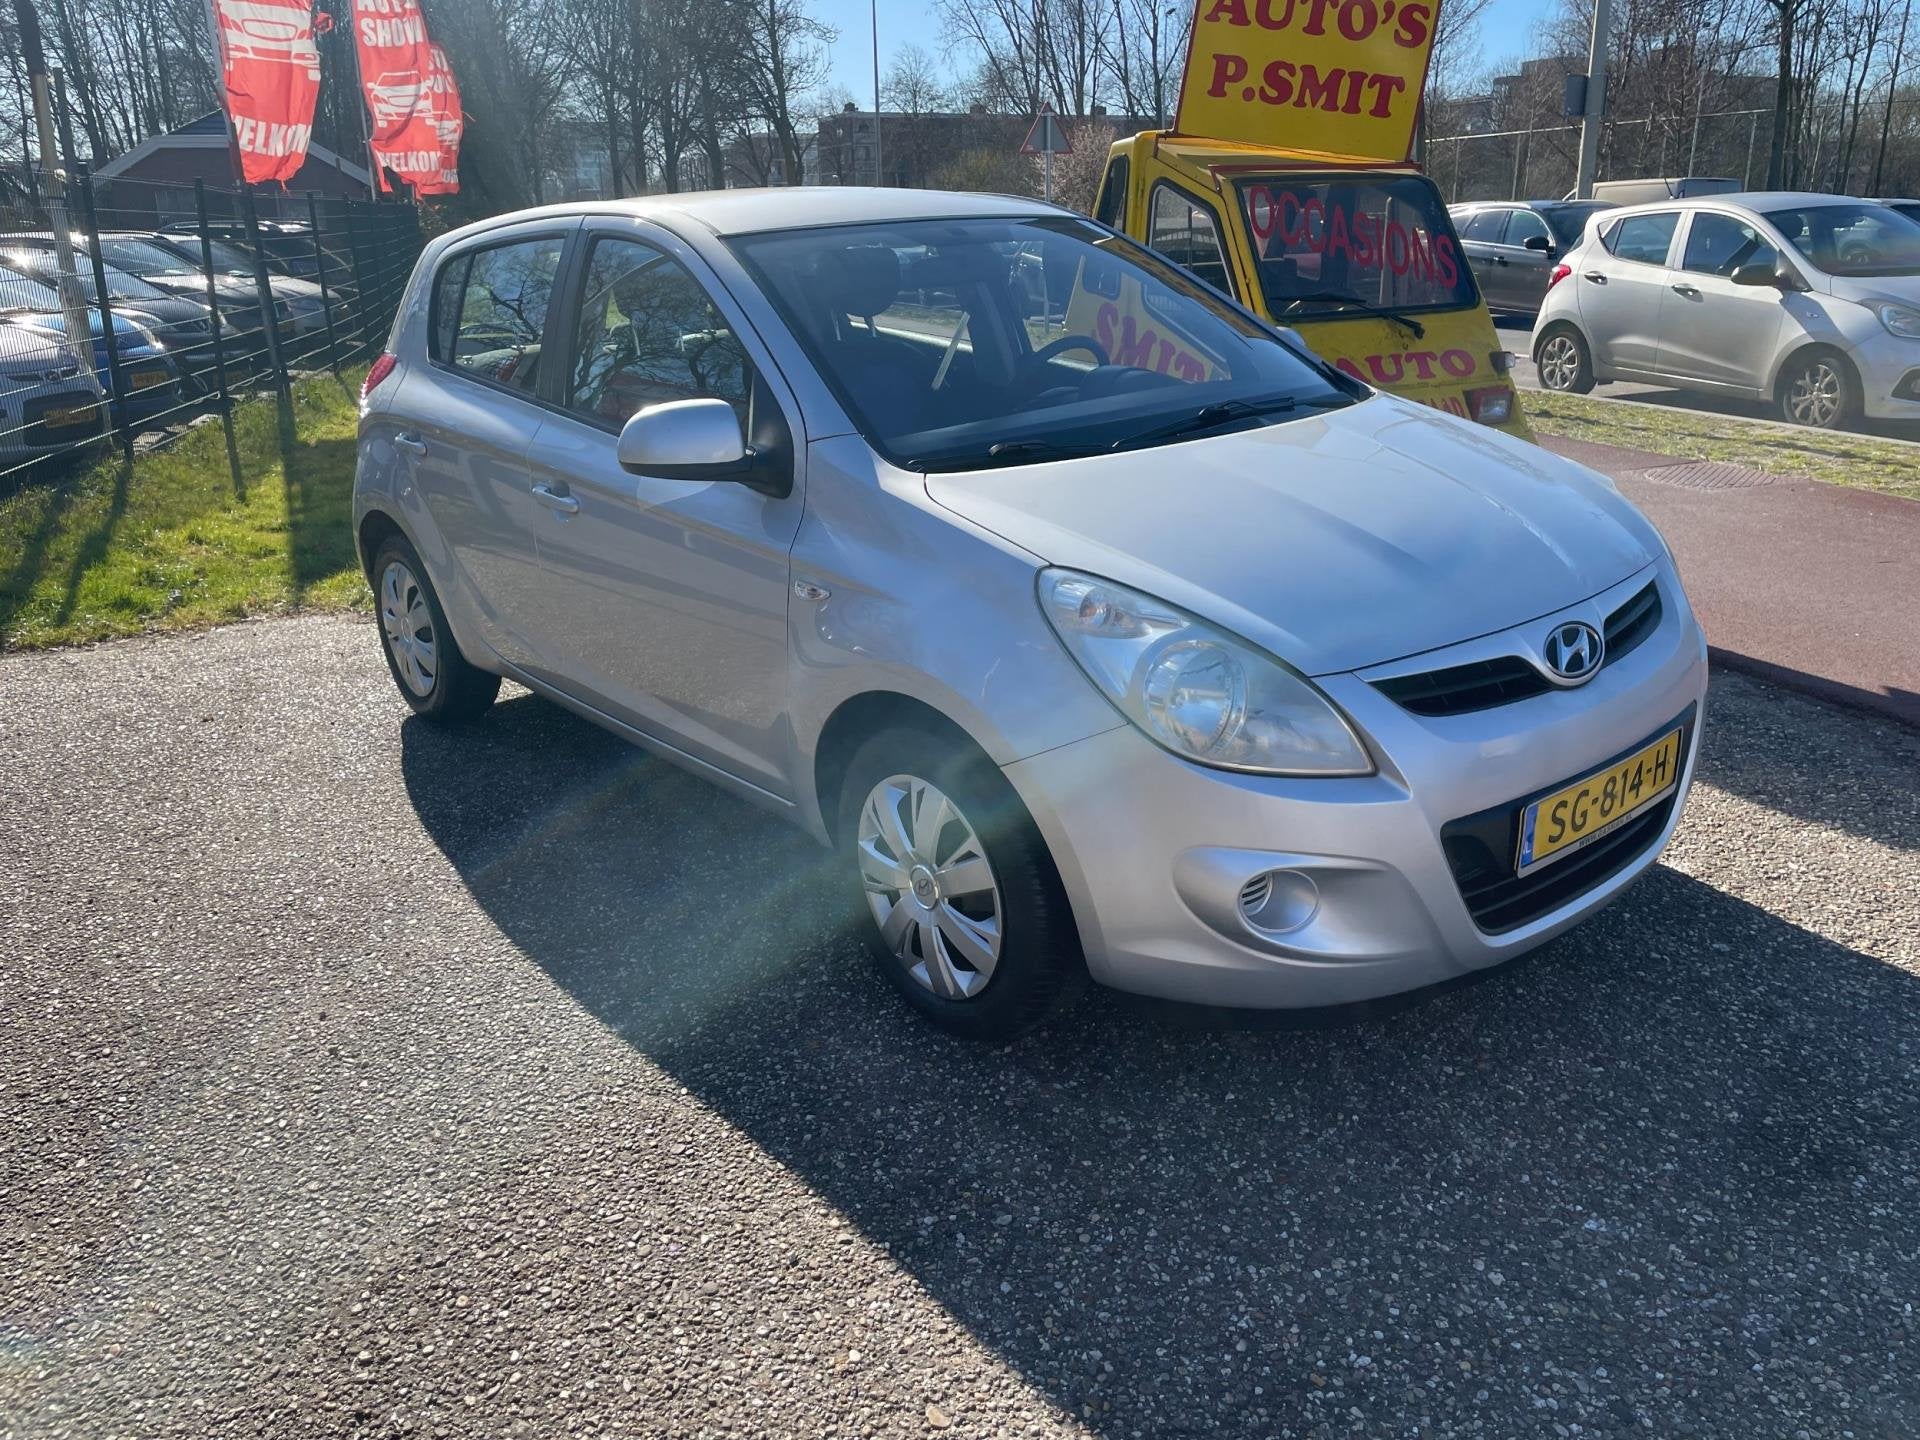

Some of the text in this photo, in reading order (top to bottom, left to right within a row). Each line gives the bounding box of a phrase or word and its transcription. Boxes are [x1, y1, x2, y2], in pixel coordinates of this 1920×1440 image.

[360, 15, 424, 48] SHOW
[1204, 0, 1430, 48] AUTO'S
[1207, 53, 1406, 119] P.SMIT
[1250, 186, 1458, 289] OCCASIONS
[1548, 744, 1669, 844] SG-814-H
